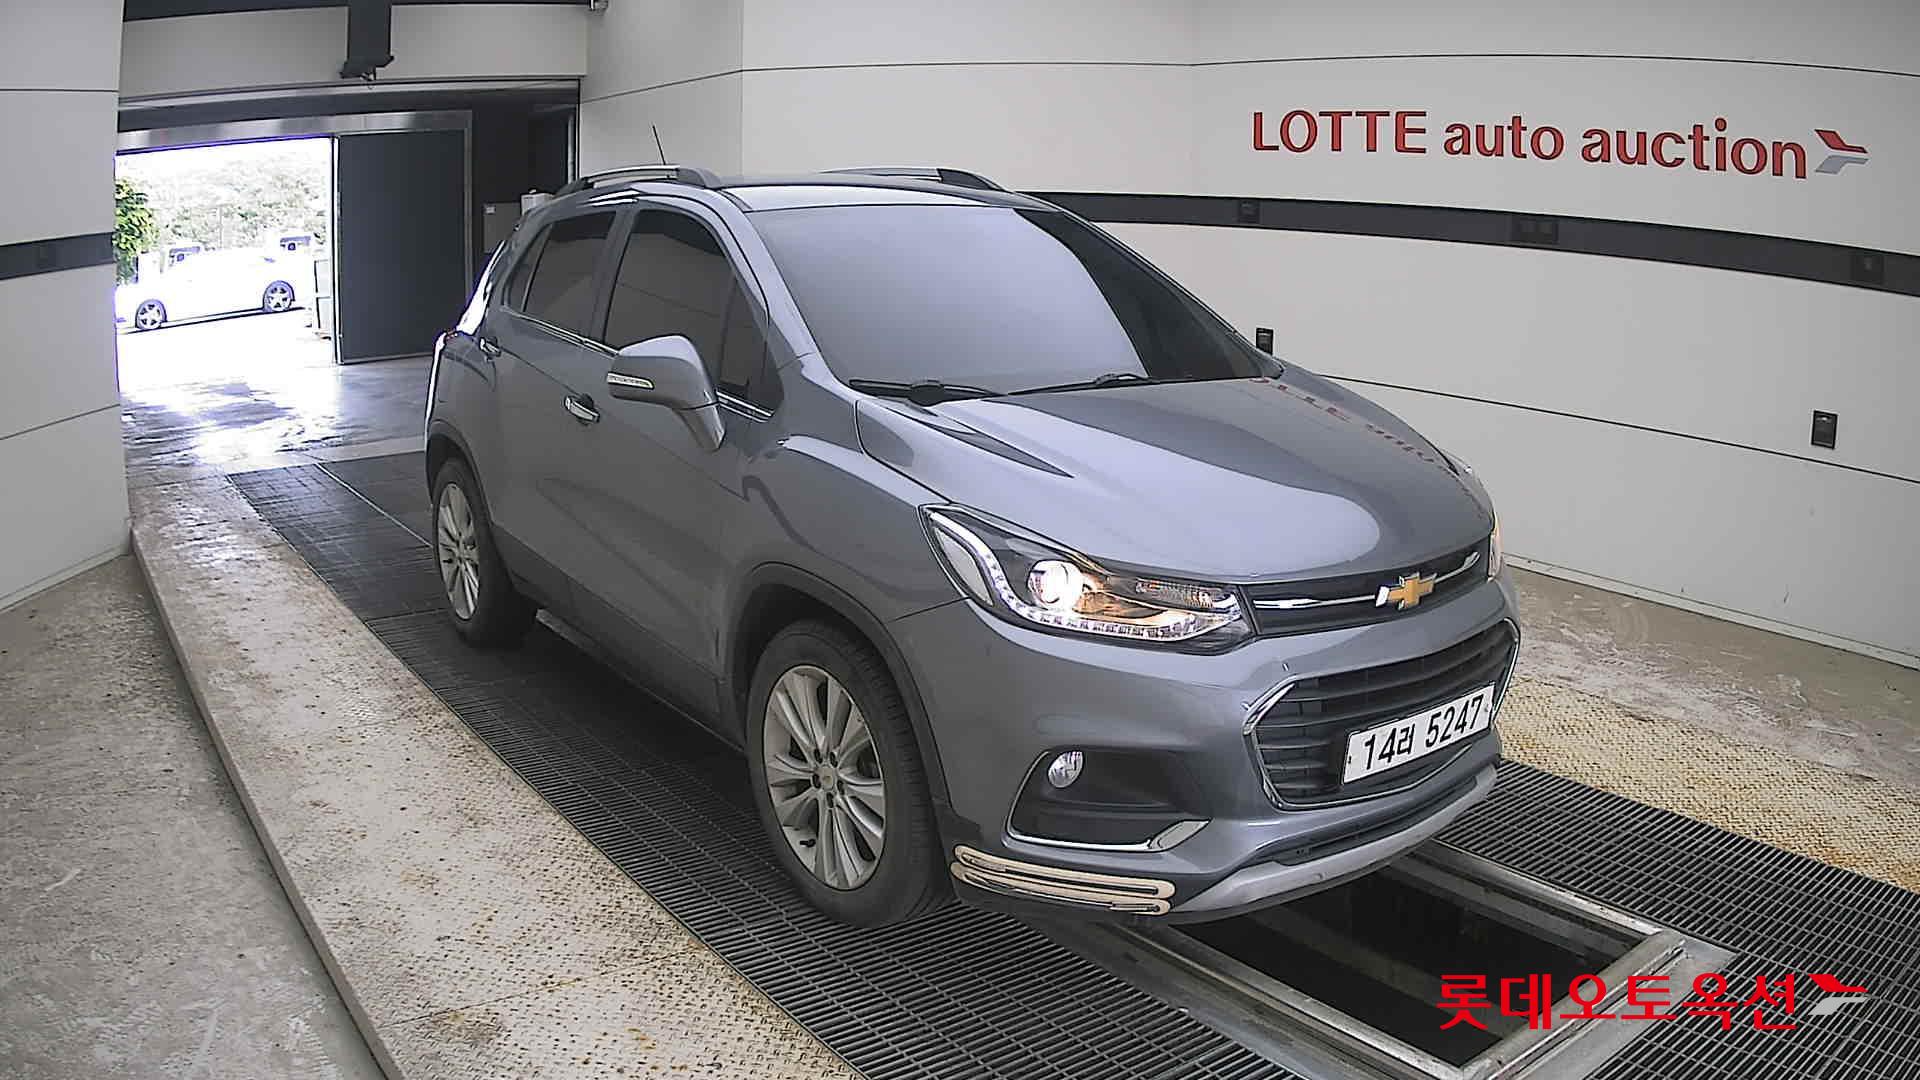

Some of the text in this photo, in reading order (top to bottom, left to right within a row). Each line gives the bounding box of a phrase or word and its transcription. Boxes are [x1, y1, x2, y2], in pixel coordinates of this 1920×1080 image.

[1252, 109, 1808, 180] LOTTE auto auction
[1364, 694, 1484, 770] 14러 5247
